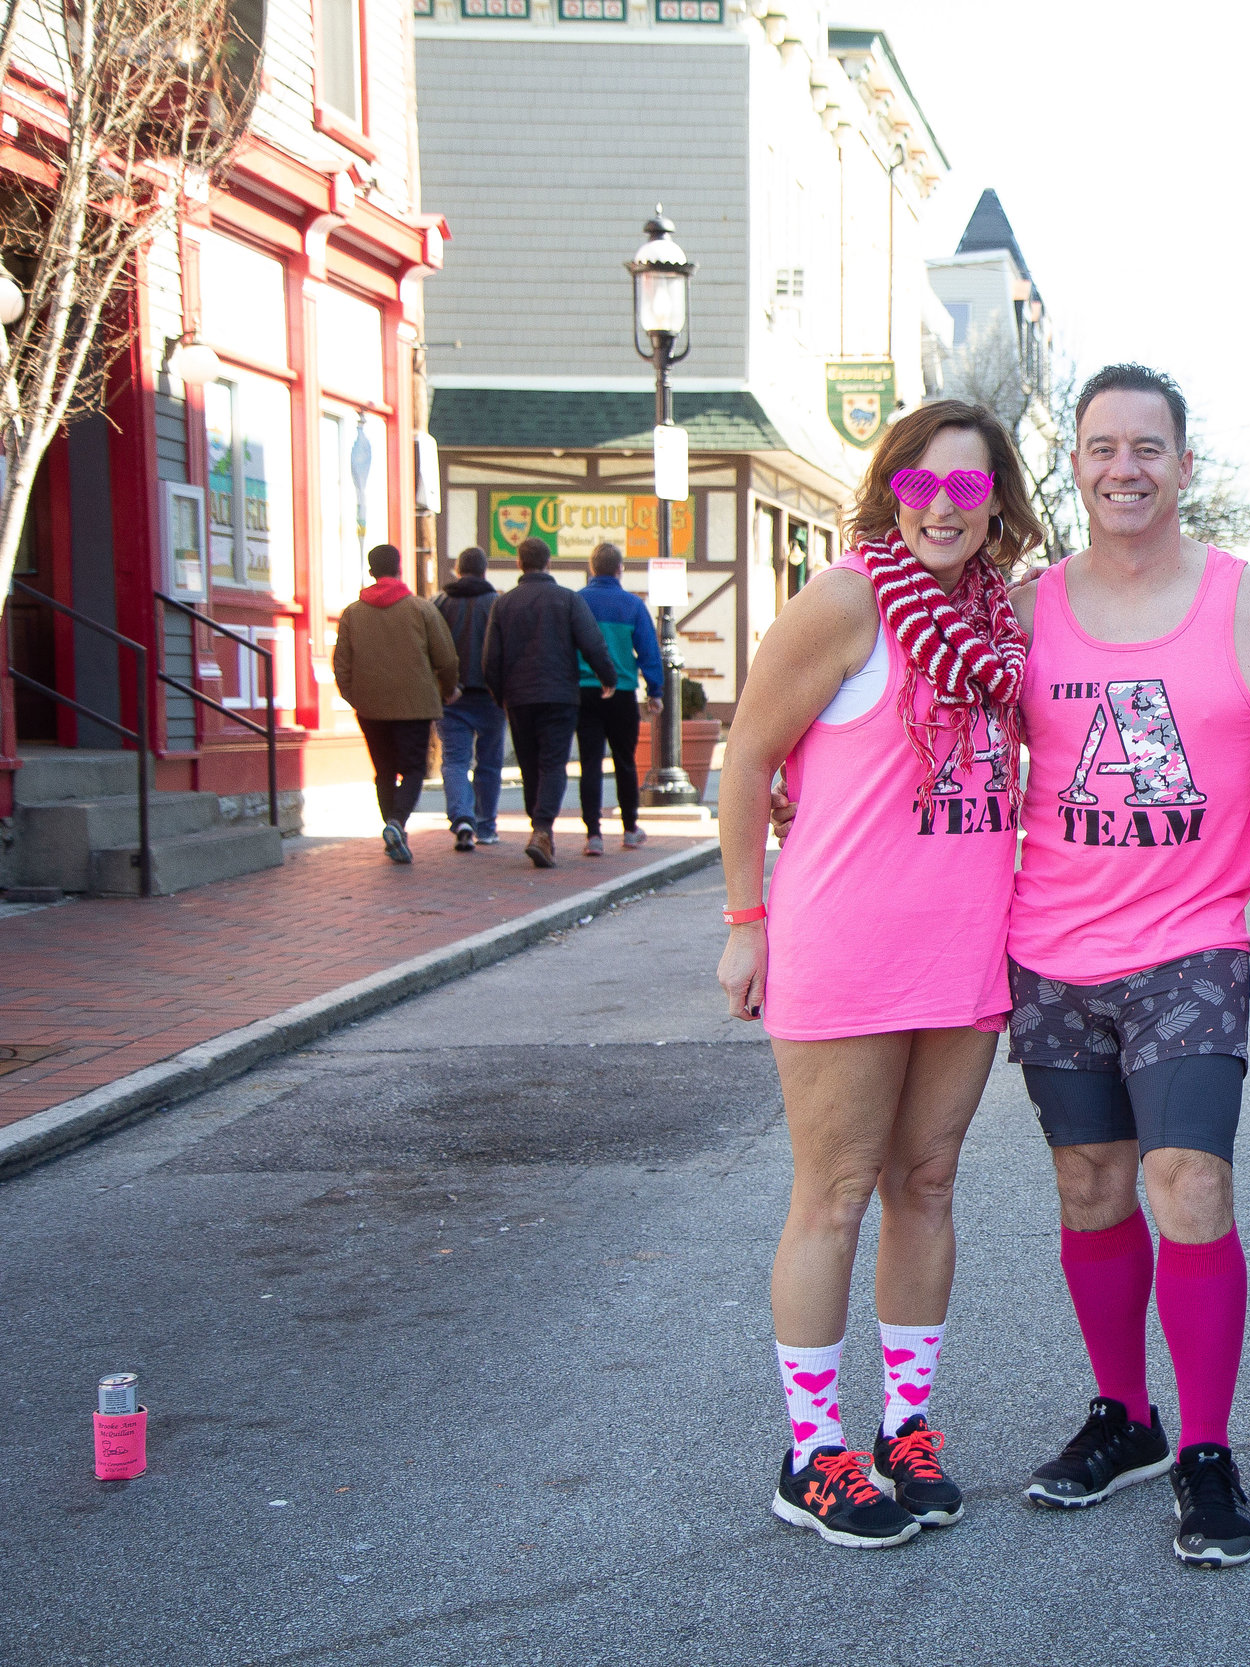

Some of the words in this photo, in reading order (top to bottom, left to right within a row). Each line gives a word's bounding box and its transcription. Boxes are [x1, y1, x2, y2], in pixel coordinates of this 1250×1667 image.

[1050, 682, 1100, 701] THE
[1058, 679, 1208, 807] A
[1058, 804, 1207, 847] TEAM
